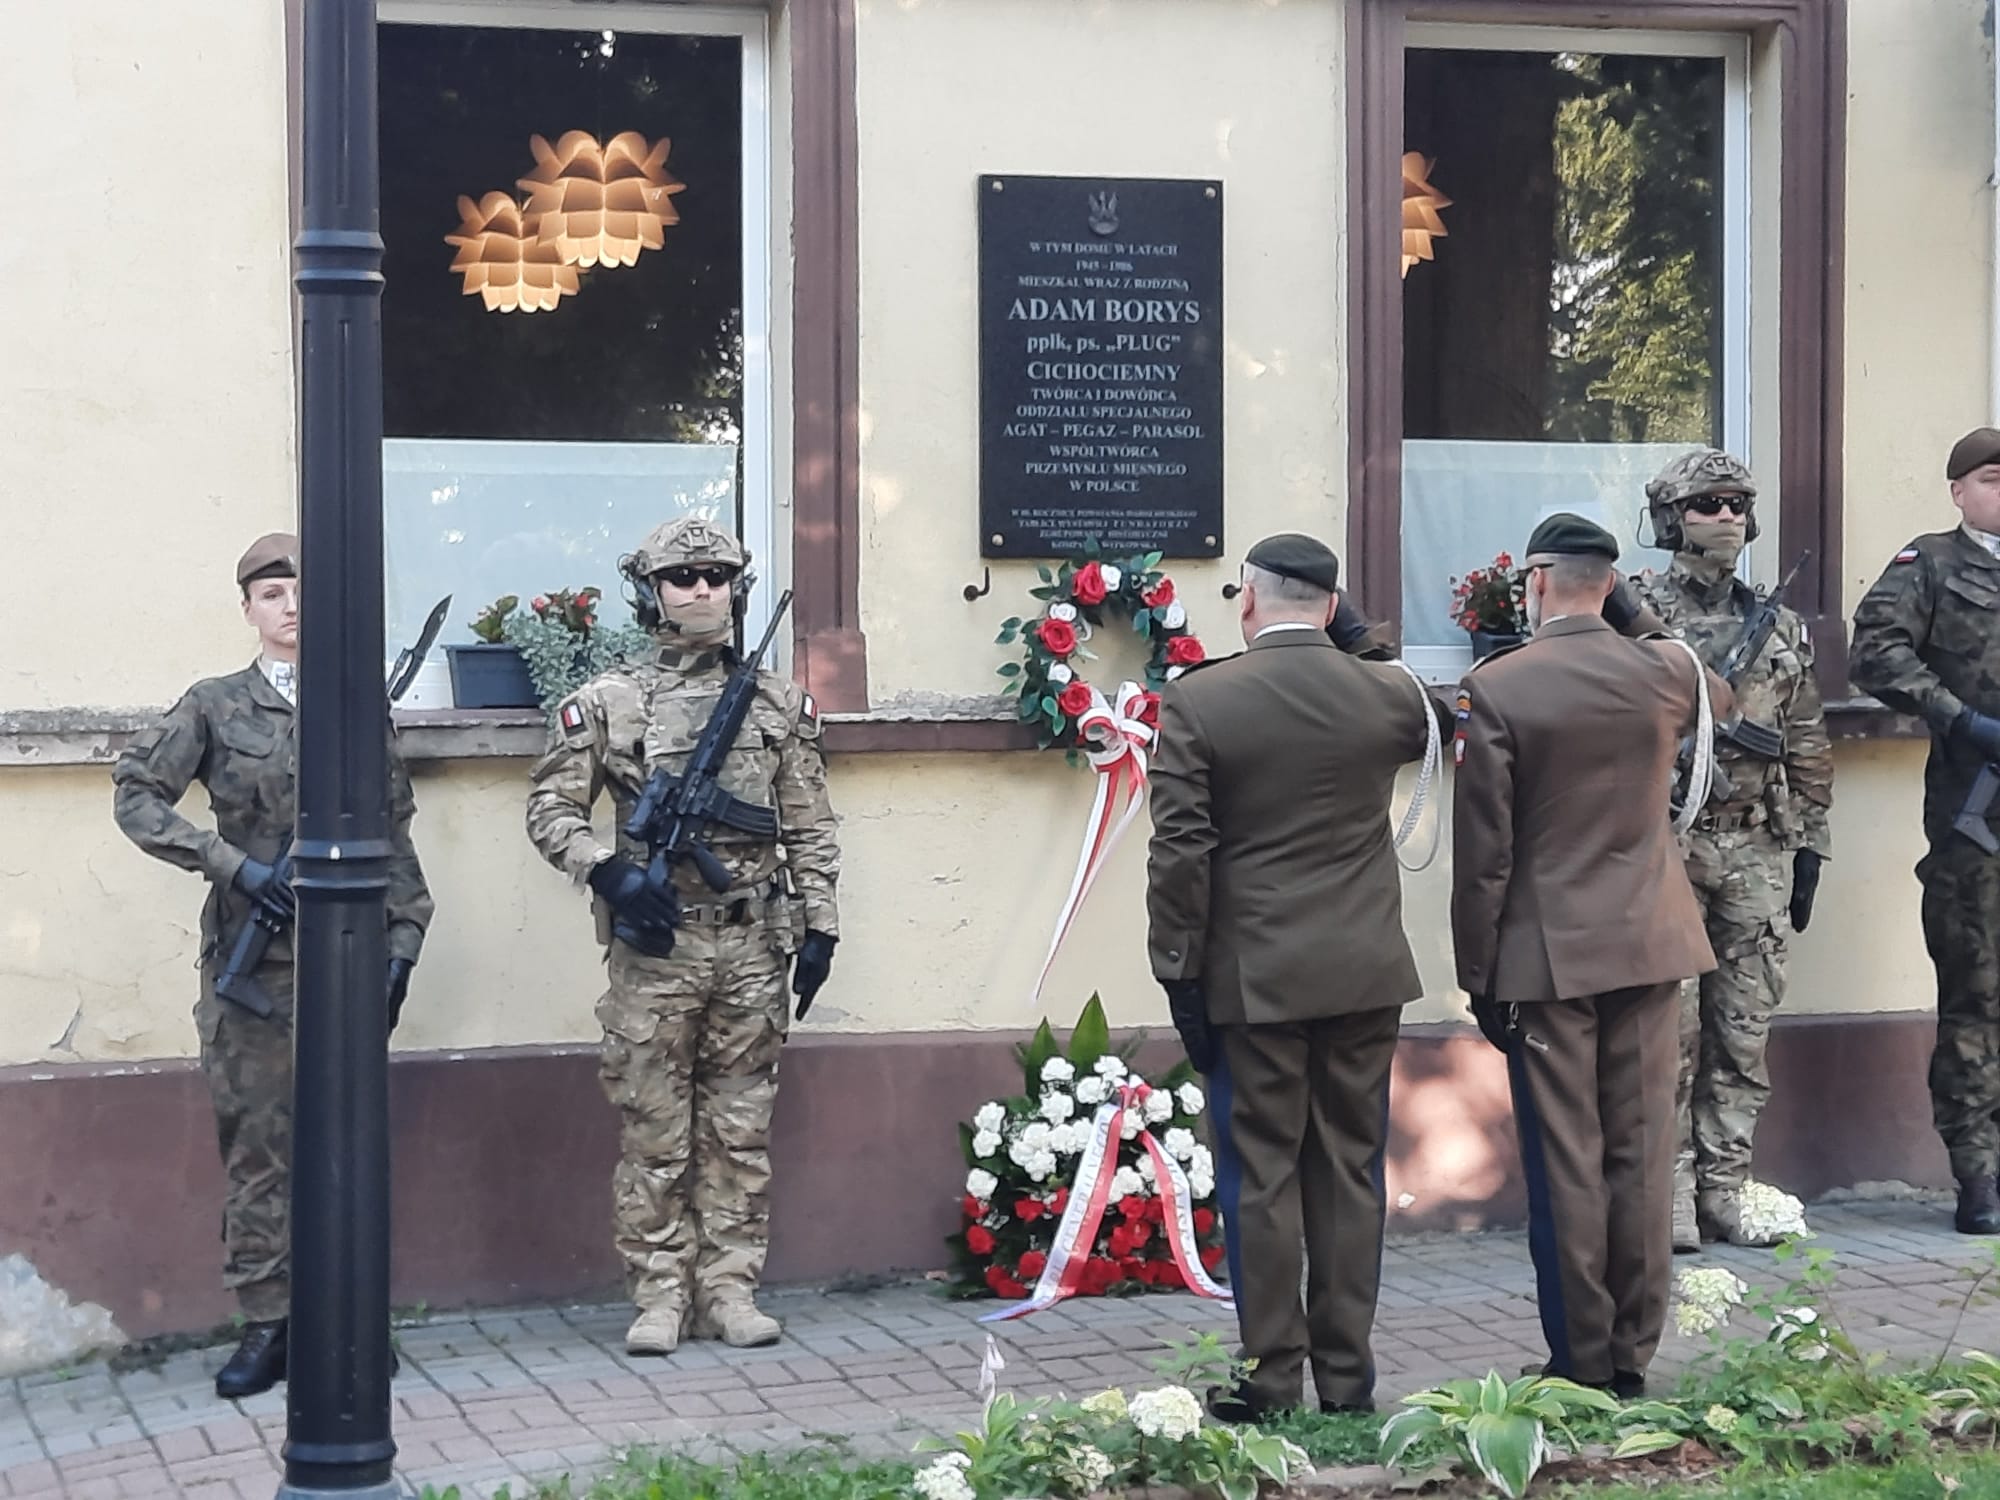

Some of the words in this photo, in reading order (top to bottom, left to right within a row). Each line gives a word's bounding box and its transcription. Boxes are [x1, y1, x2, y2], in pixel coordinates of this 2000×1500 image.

[1045, 242, 1073, 254] TYM
[1128, 244, 1178, 256] LATACH
[1083, 277, 1121, 289] WRAZ
[1008, 297, 1097, 322] ADAM
[1104, 299, 1201, 324] BORYS
[1027, 360, 1182, 382] CICHOCIEMNY
[1031, 385, 1095, 401] TWÓRCA
[1104, 386, 1177, 402] DOWÓDCA
[1092, 406, 1192, 419] SPECJALNEGO
[1003, 423, 1048, 437] AGAT
[1063, 424, 1117, 438] PEGAZ
[1132, 424, 1205, 439] PARASOL
[1086, 480, 1140, 493] POLSCE
